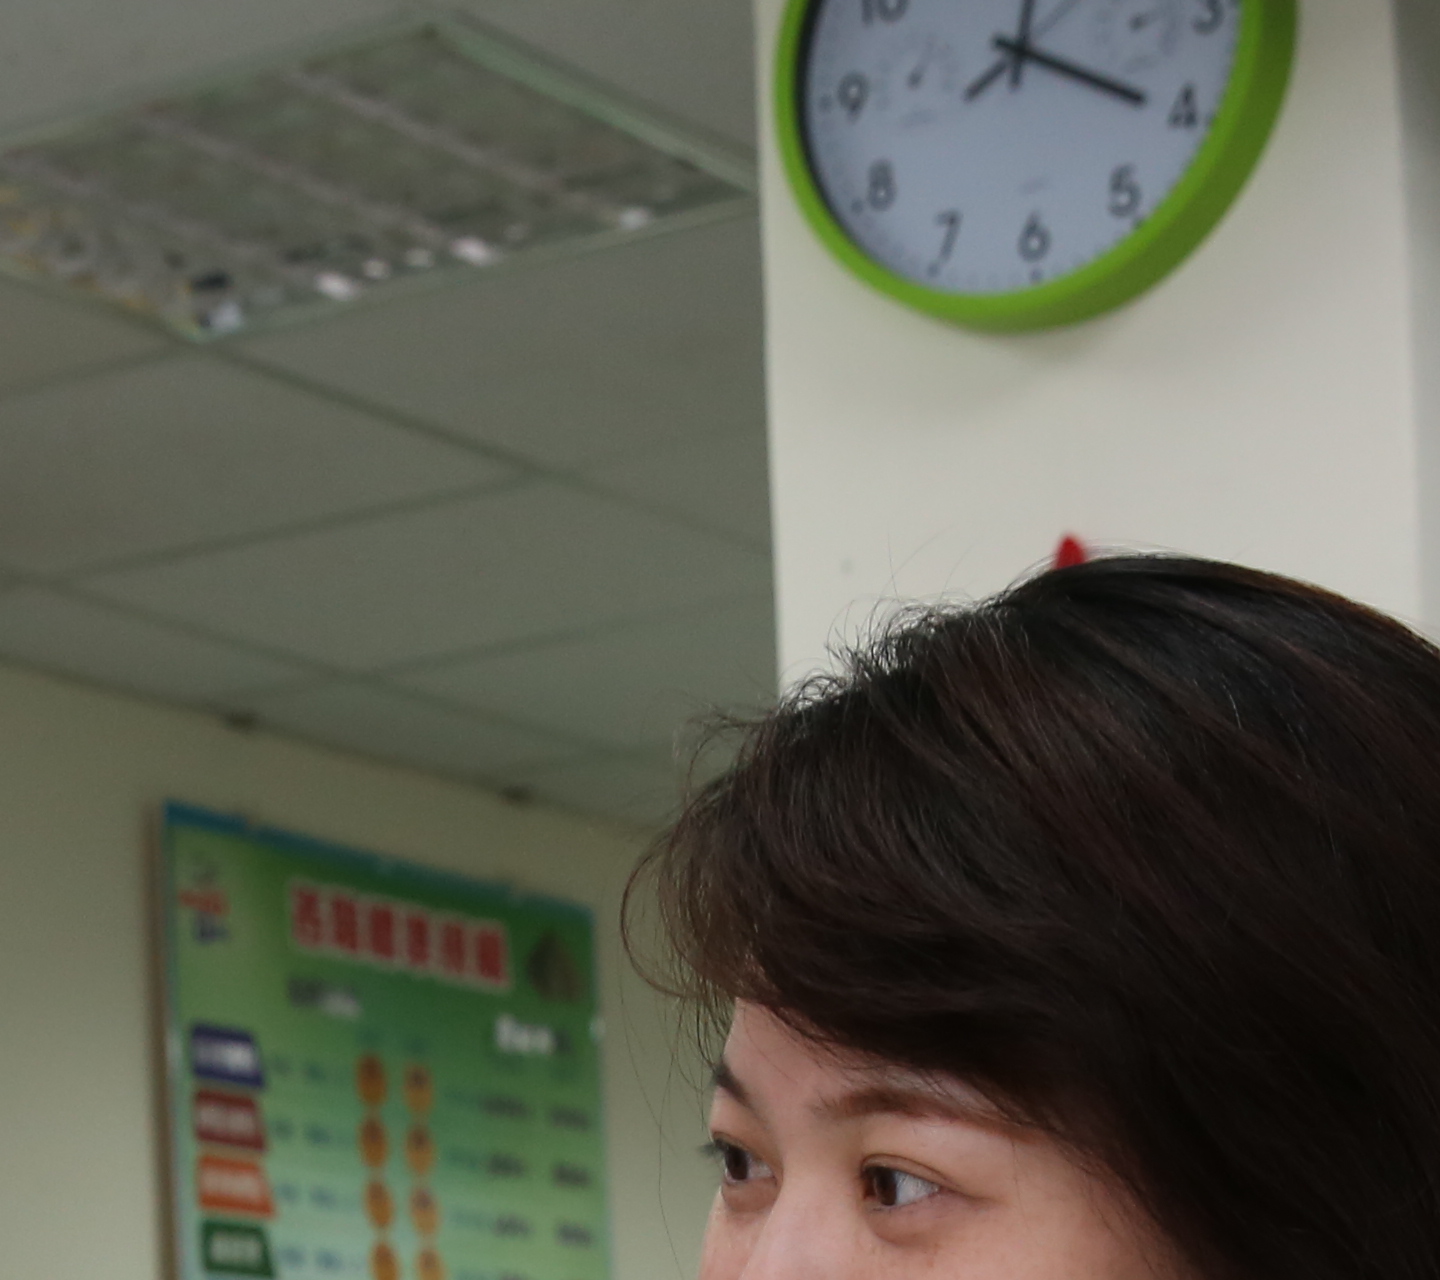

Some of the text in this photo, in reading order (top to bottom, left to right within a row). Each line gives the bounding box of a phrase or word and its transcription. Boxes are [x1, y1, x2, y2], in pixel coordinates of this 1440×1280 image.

[838, 72, 869, 123] 9
[1168, 83, 1198, 128] 4
[867, 159, 898, 211] 8
[1108, 164, 1141, 218] 5
[935, 210, 962, 264] 7
[1017, 212, 1051, 262] 6
